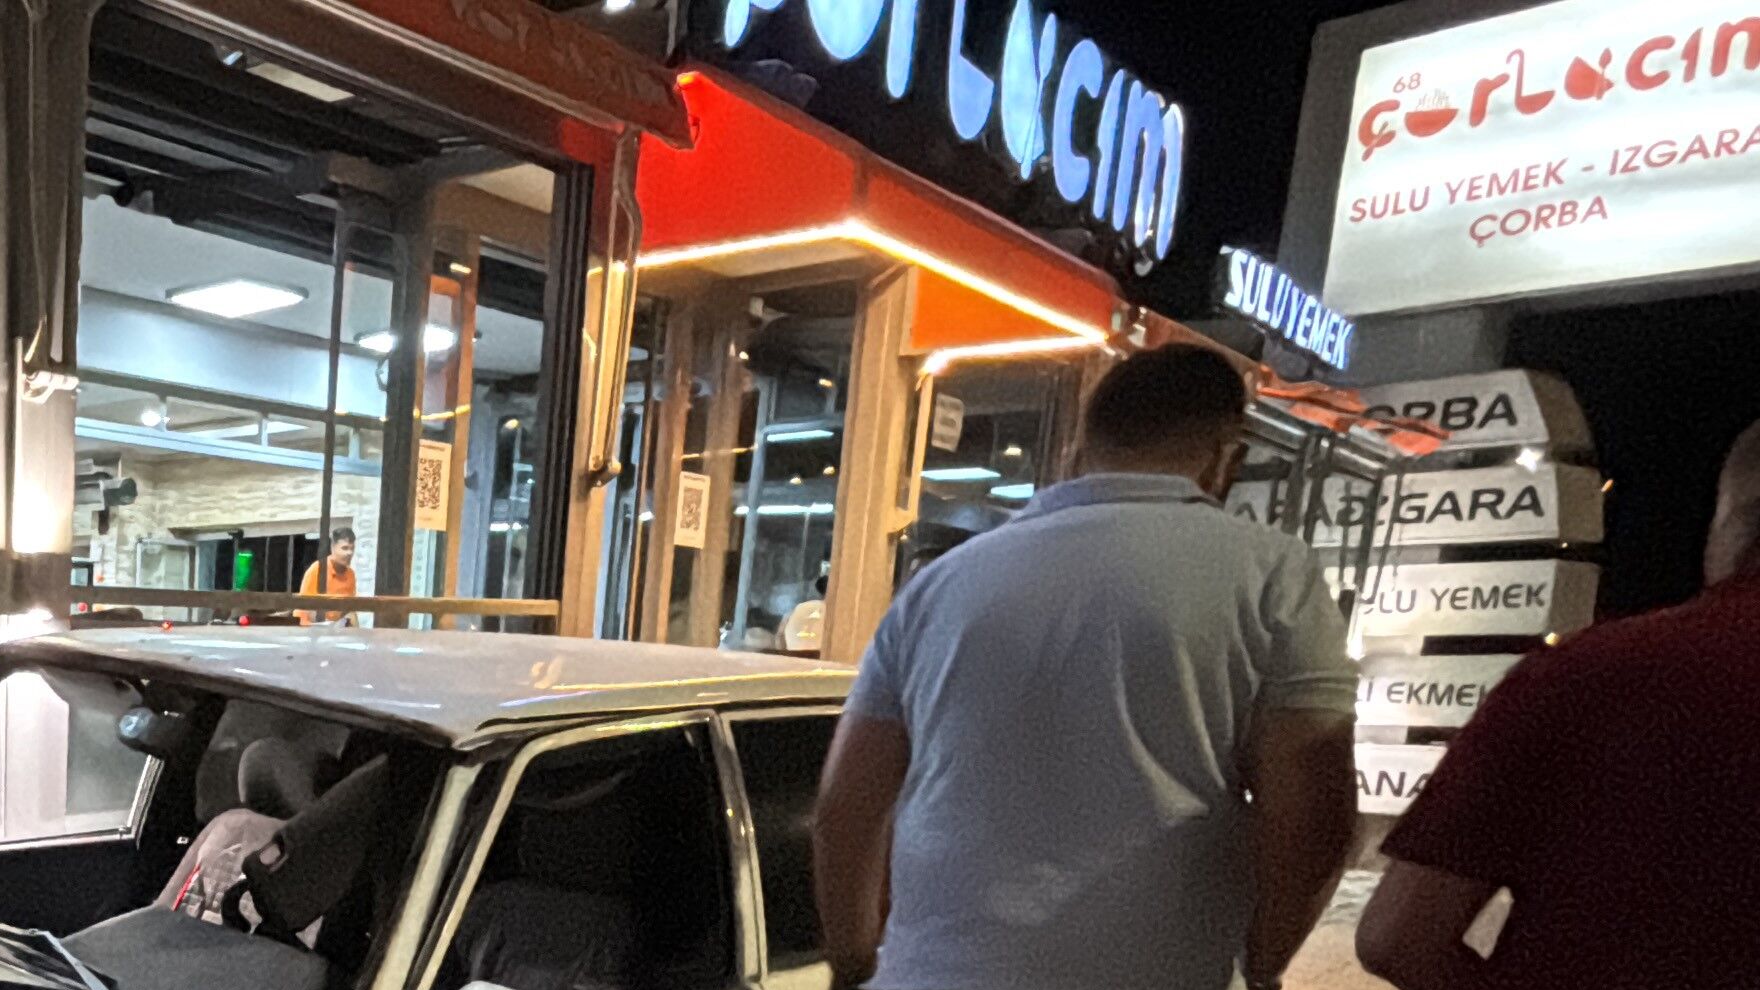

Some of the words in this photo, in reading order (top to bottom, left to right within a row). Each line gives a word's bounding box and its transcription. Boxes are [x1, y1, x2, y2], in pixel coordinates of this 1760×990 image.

[1392, 72, 1422, 94] 68
[1349, 186, 1430, 223] SULU
[1444, 158, 1568, 205] YEMEK
[1608, 124, 1760, 176] IZGARA
[1469, 196, 1608, 247] ÇORBA
[1429, 581, 1548, 612] YEMEK
